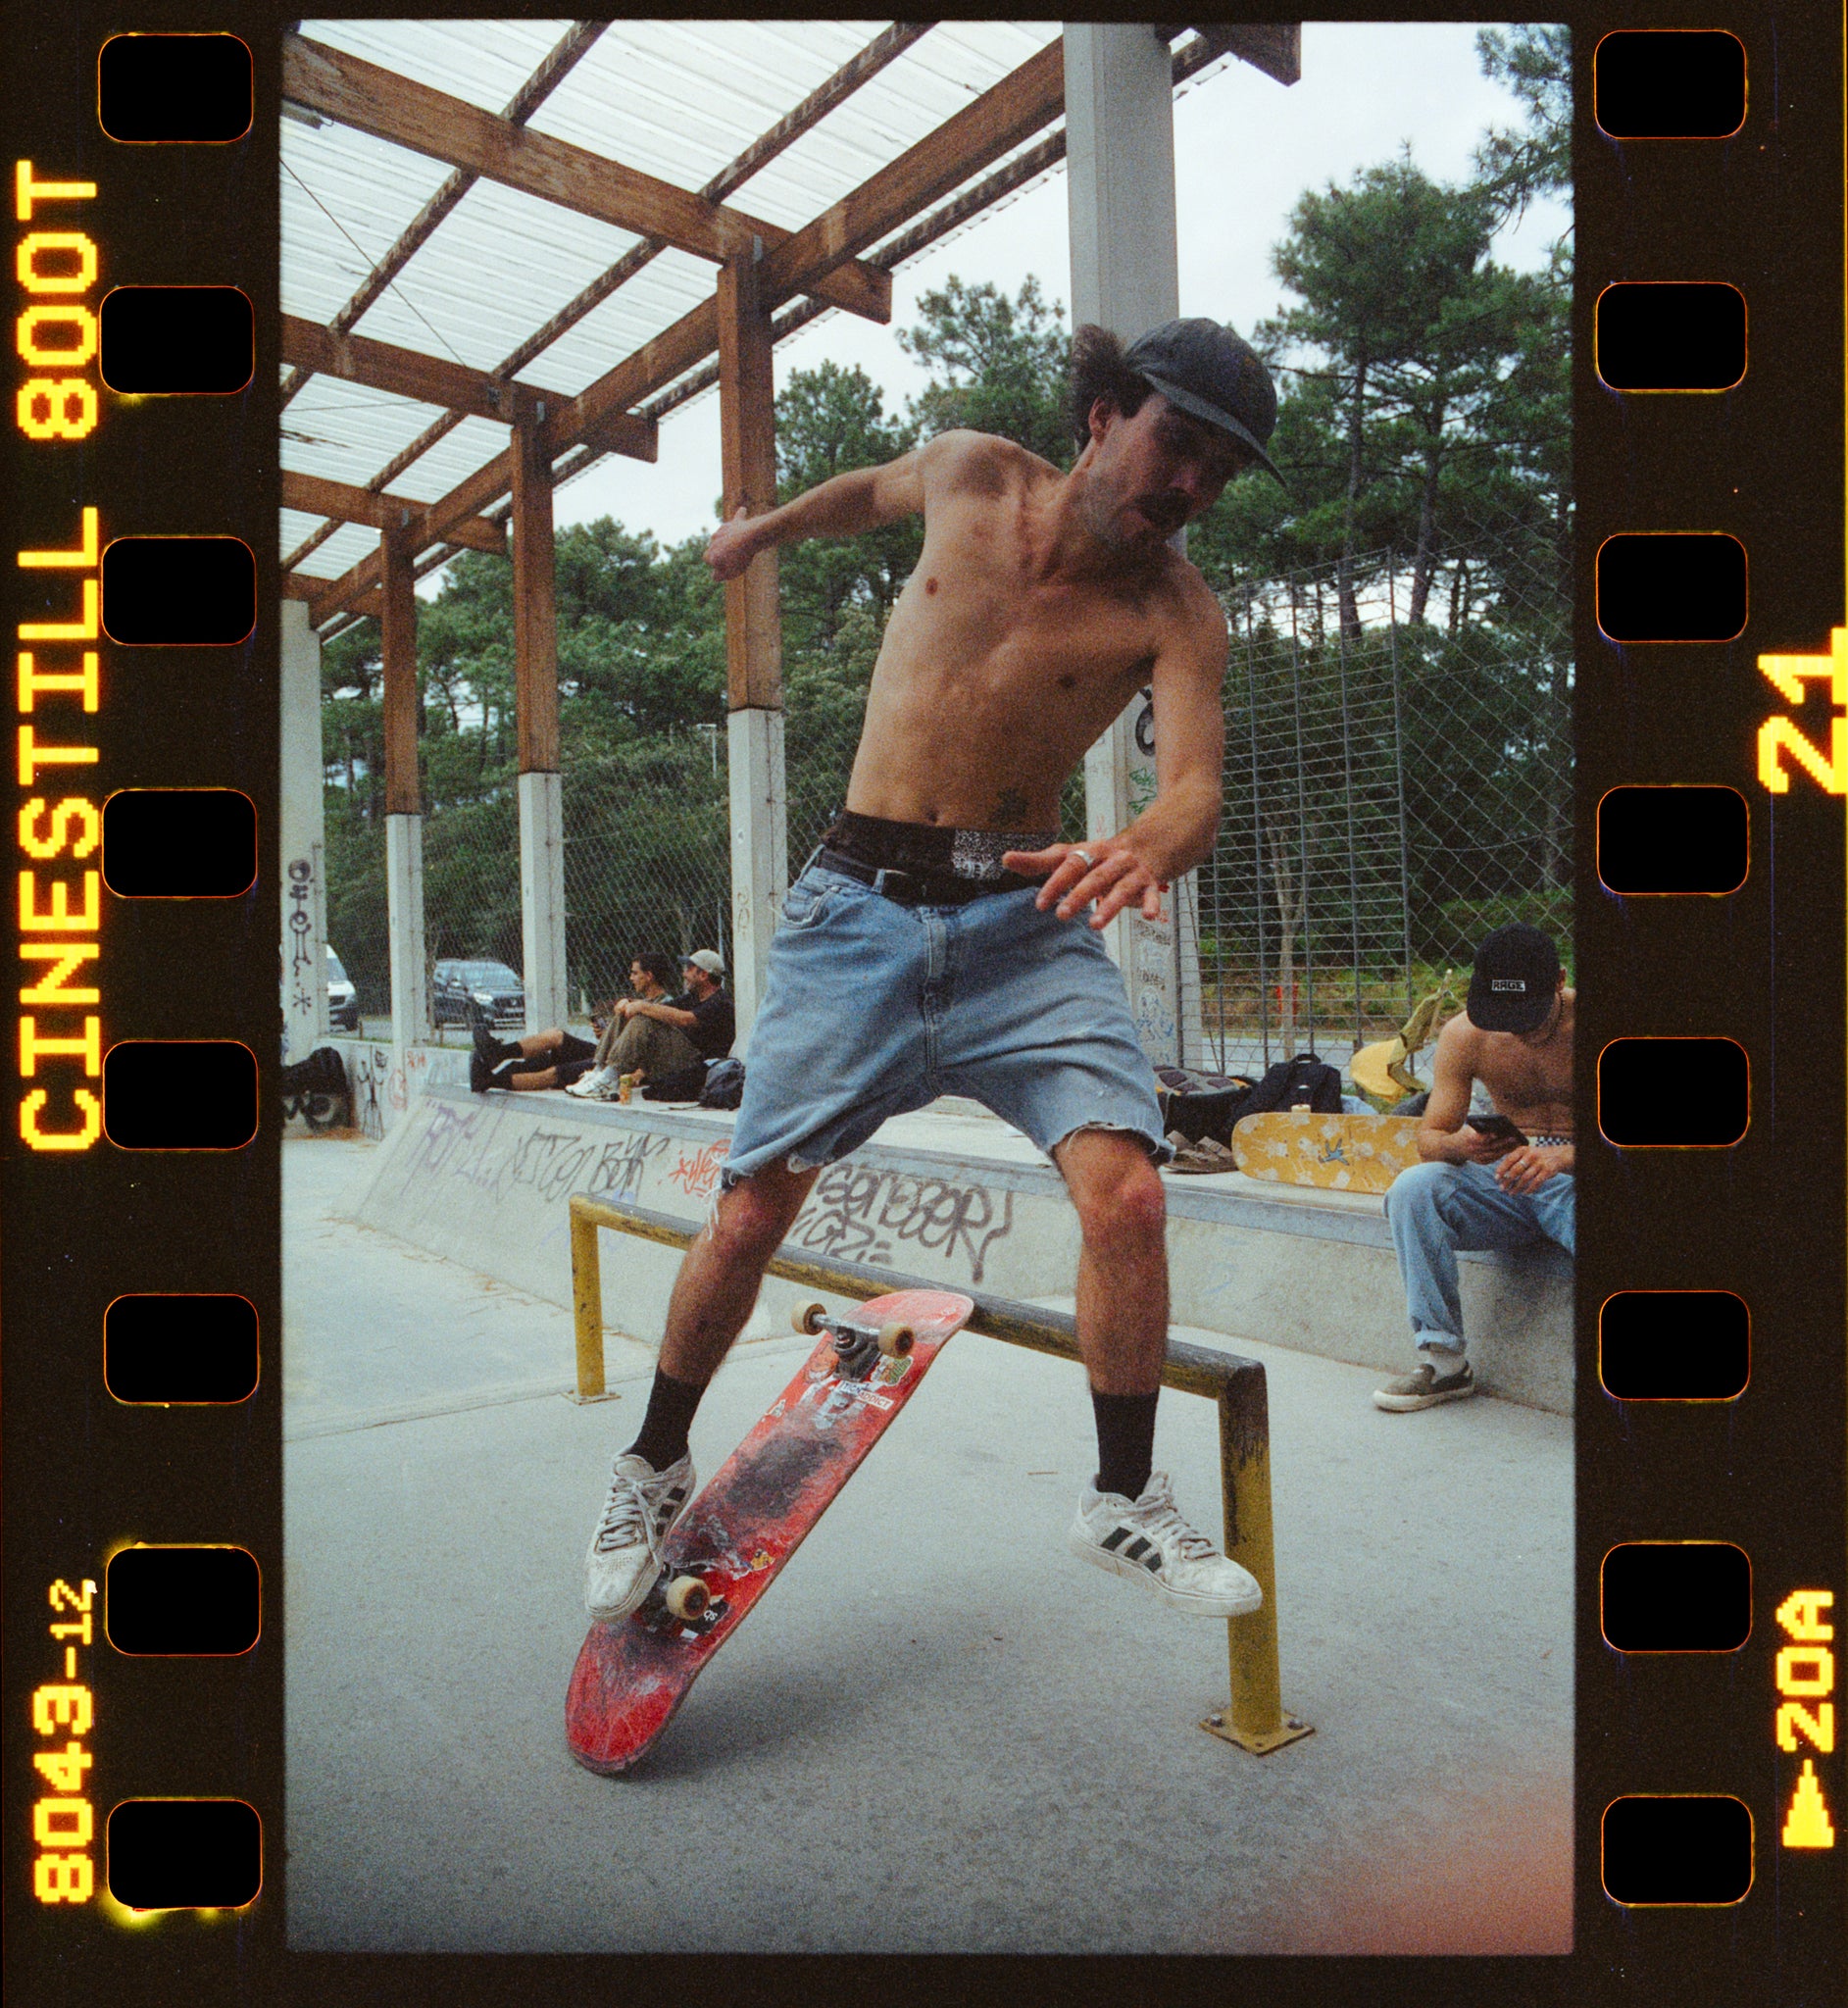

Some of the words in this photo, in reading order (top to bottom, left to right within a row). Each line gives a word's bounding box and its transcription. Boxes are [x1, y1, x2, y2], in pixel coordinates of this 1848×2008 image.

[16, 159, 99, 440] 800T
[1757, 625, 1848, 795] 21
[18, 506, 102, 1151] CINESTILL
[1492, 979, 1524, 990] RAGE
[32, 1578, 96, 1904] 8043-12
[1775, 1589, 1835, 1754] 20A
